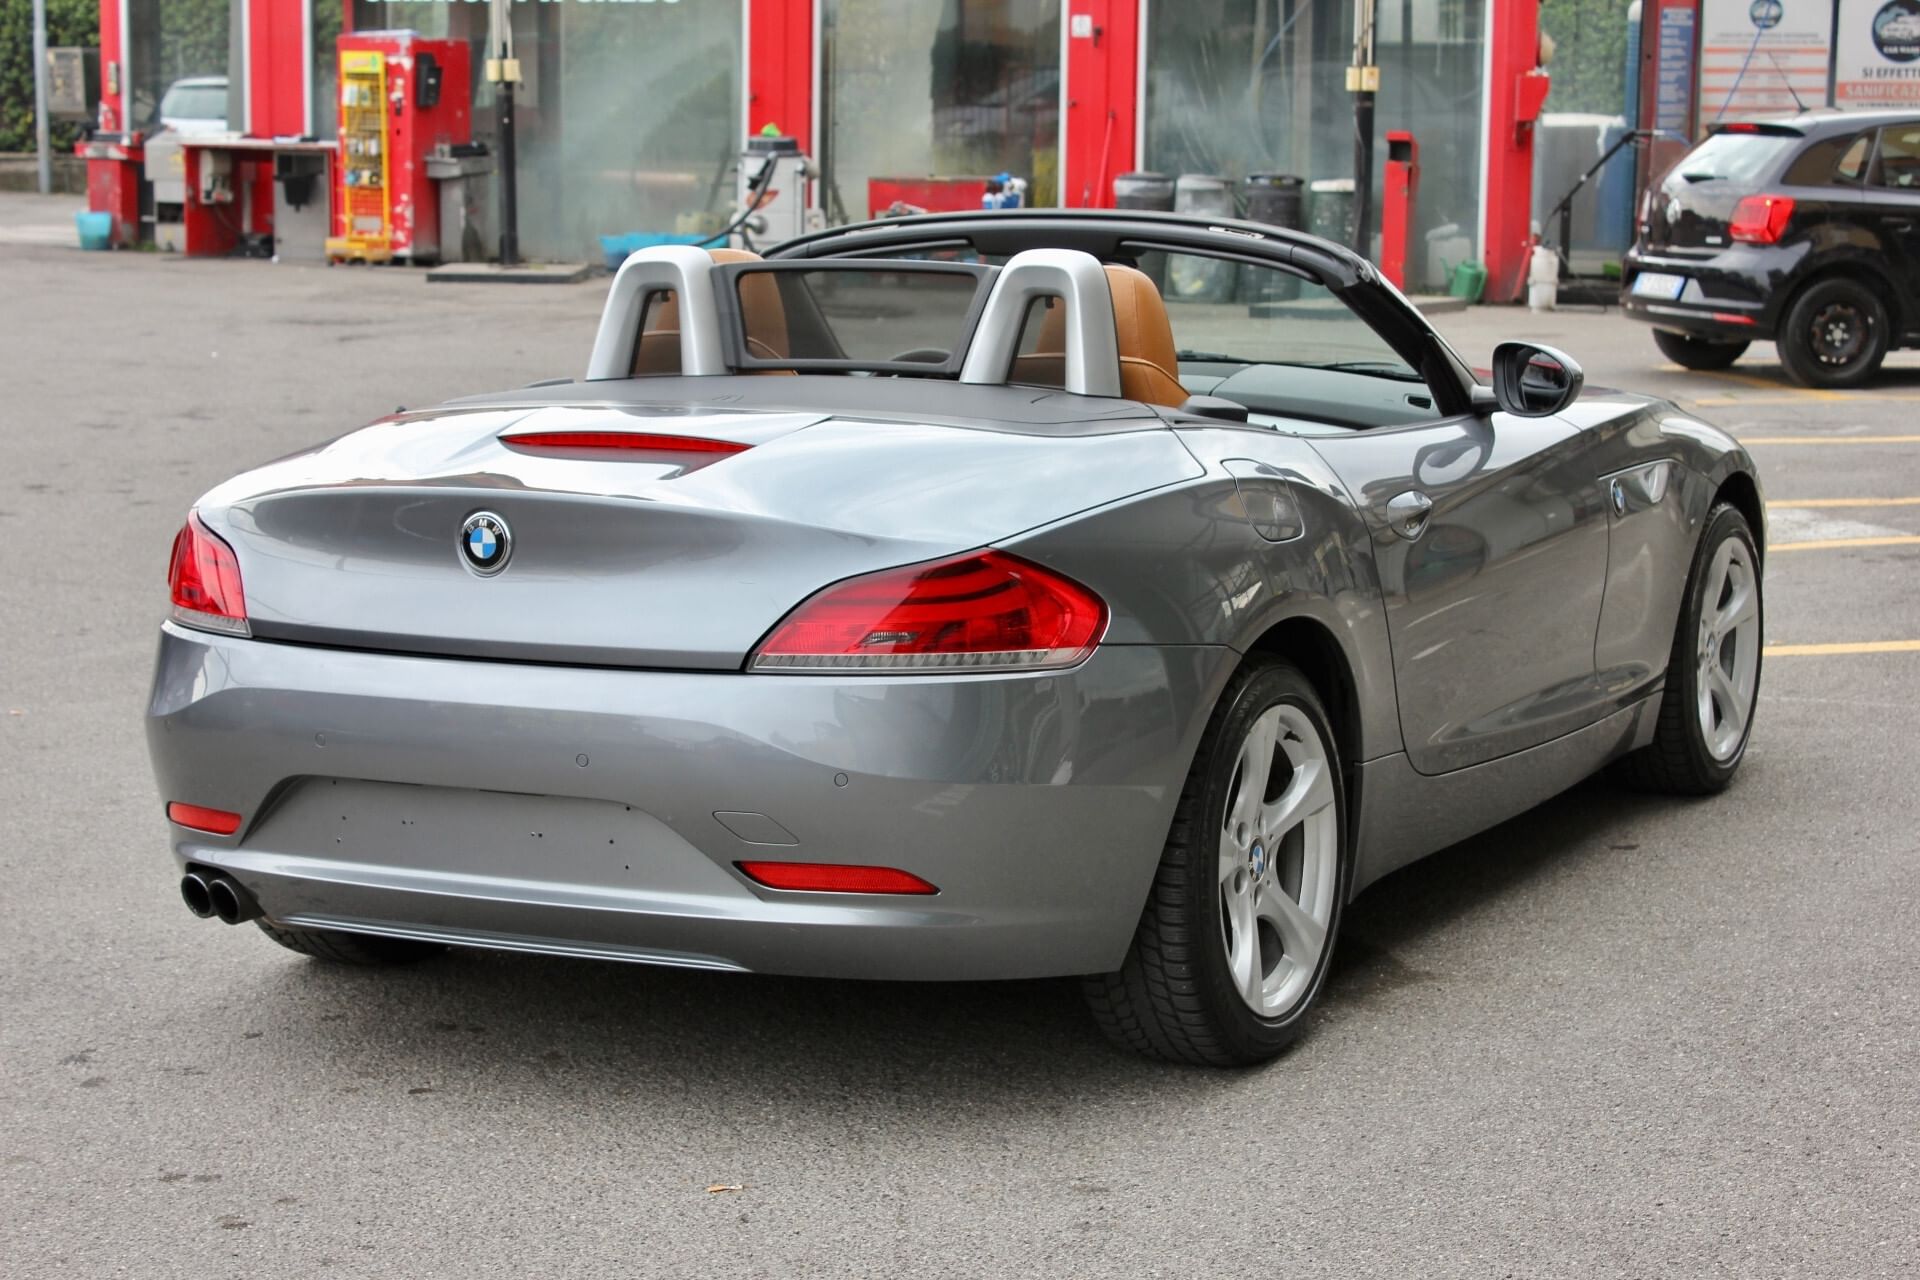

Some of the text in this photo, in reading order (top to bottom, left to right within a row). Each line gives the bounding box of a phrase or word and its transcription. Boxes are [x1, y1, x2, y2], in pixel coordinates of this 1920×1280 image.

[1862, 67, 1920, 78] SI EFFETT
[466, 518, 502, 535] BMW
